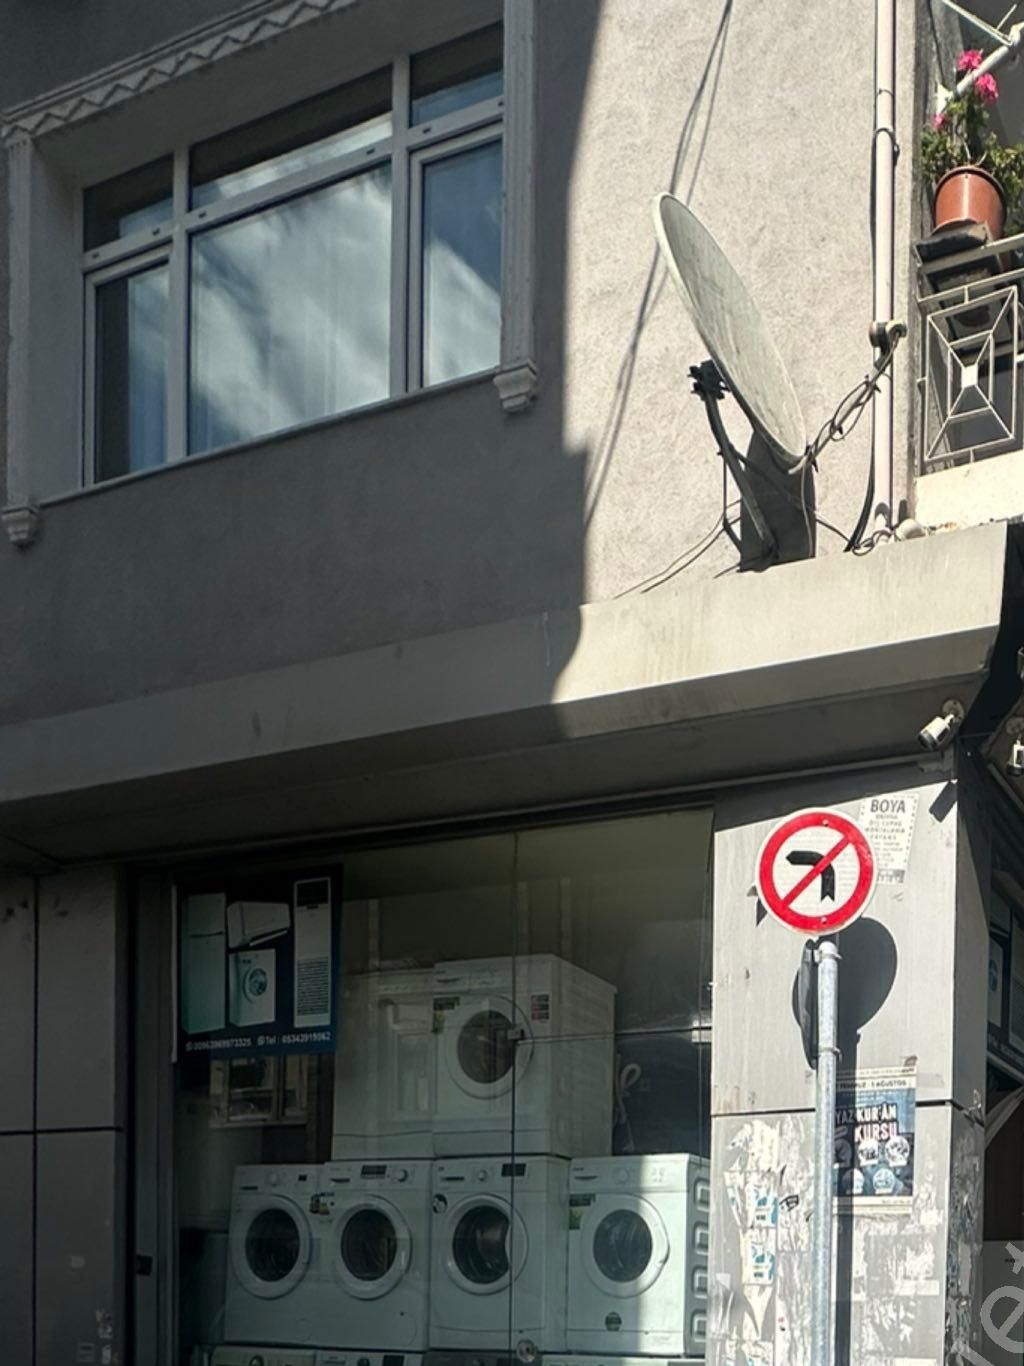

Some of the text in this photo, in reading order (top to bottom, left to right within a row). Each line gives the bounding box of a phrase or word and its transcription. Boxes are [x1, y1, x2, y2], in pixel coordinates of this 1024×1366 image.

[870, 799, 906, 814] BOYA
[876, 1079, 907, 1088] AĞUSTOS
[835, 1108, 854, 1124] YAZ
[854, 1121, 897, 1143] KURSU
